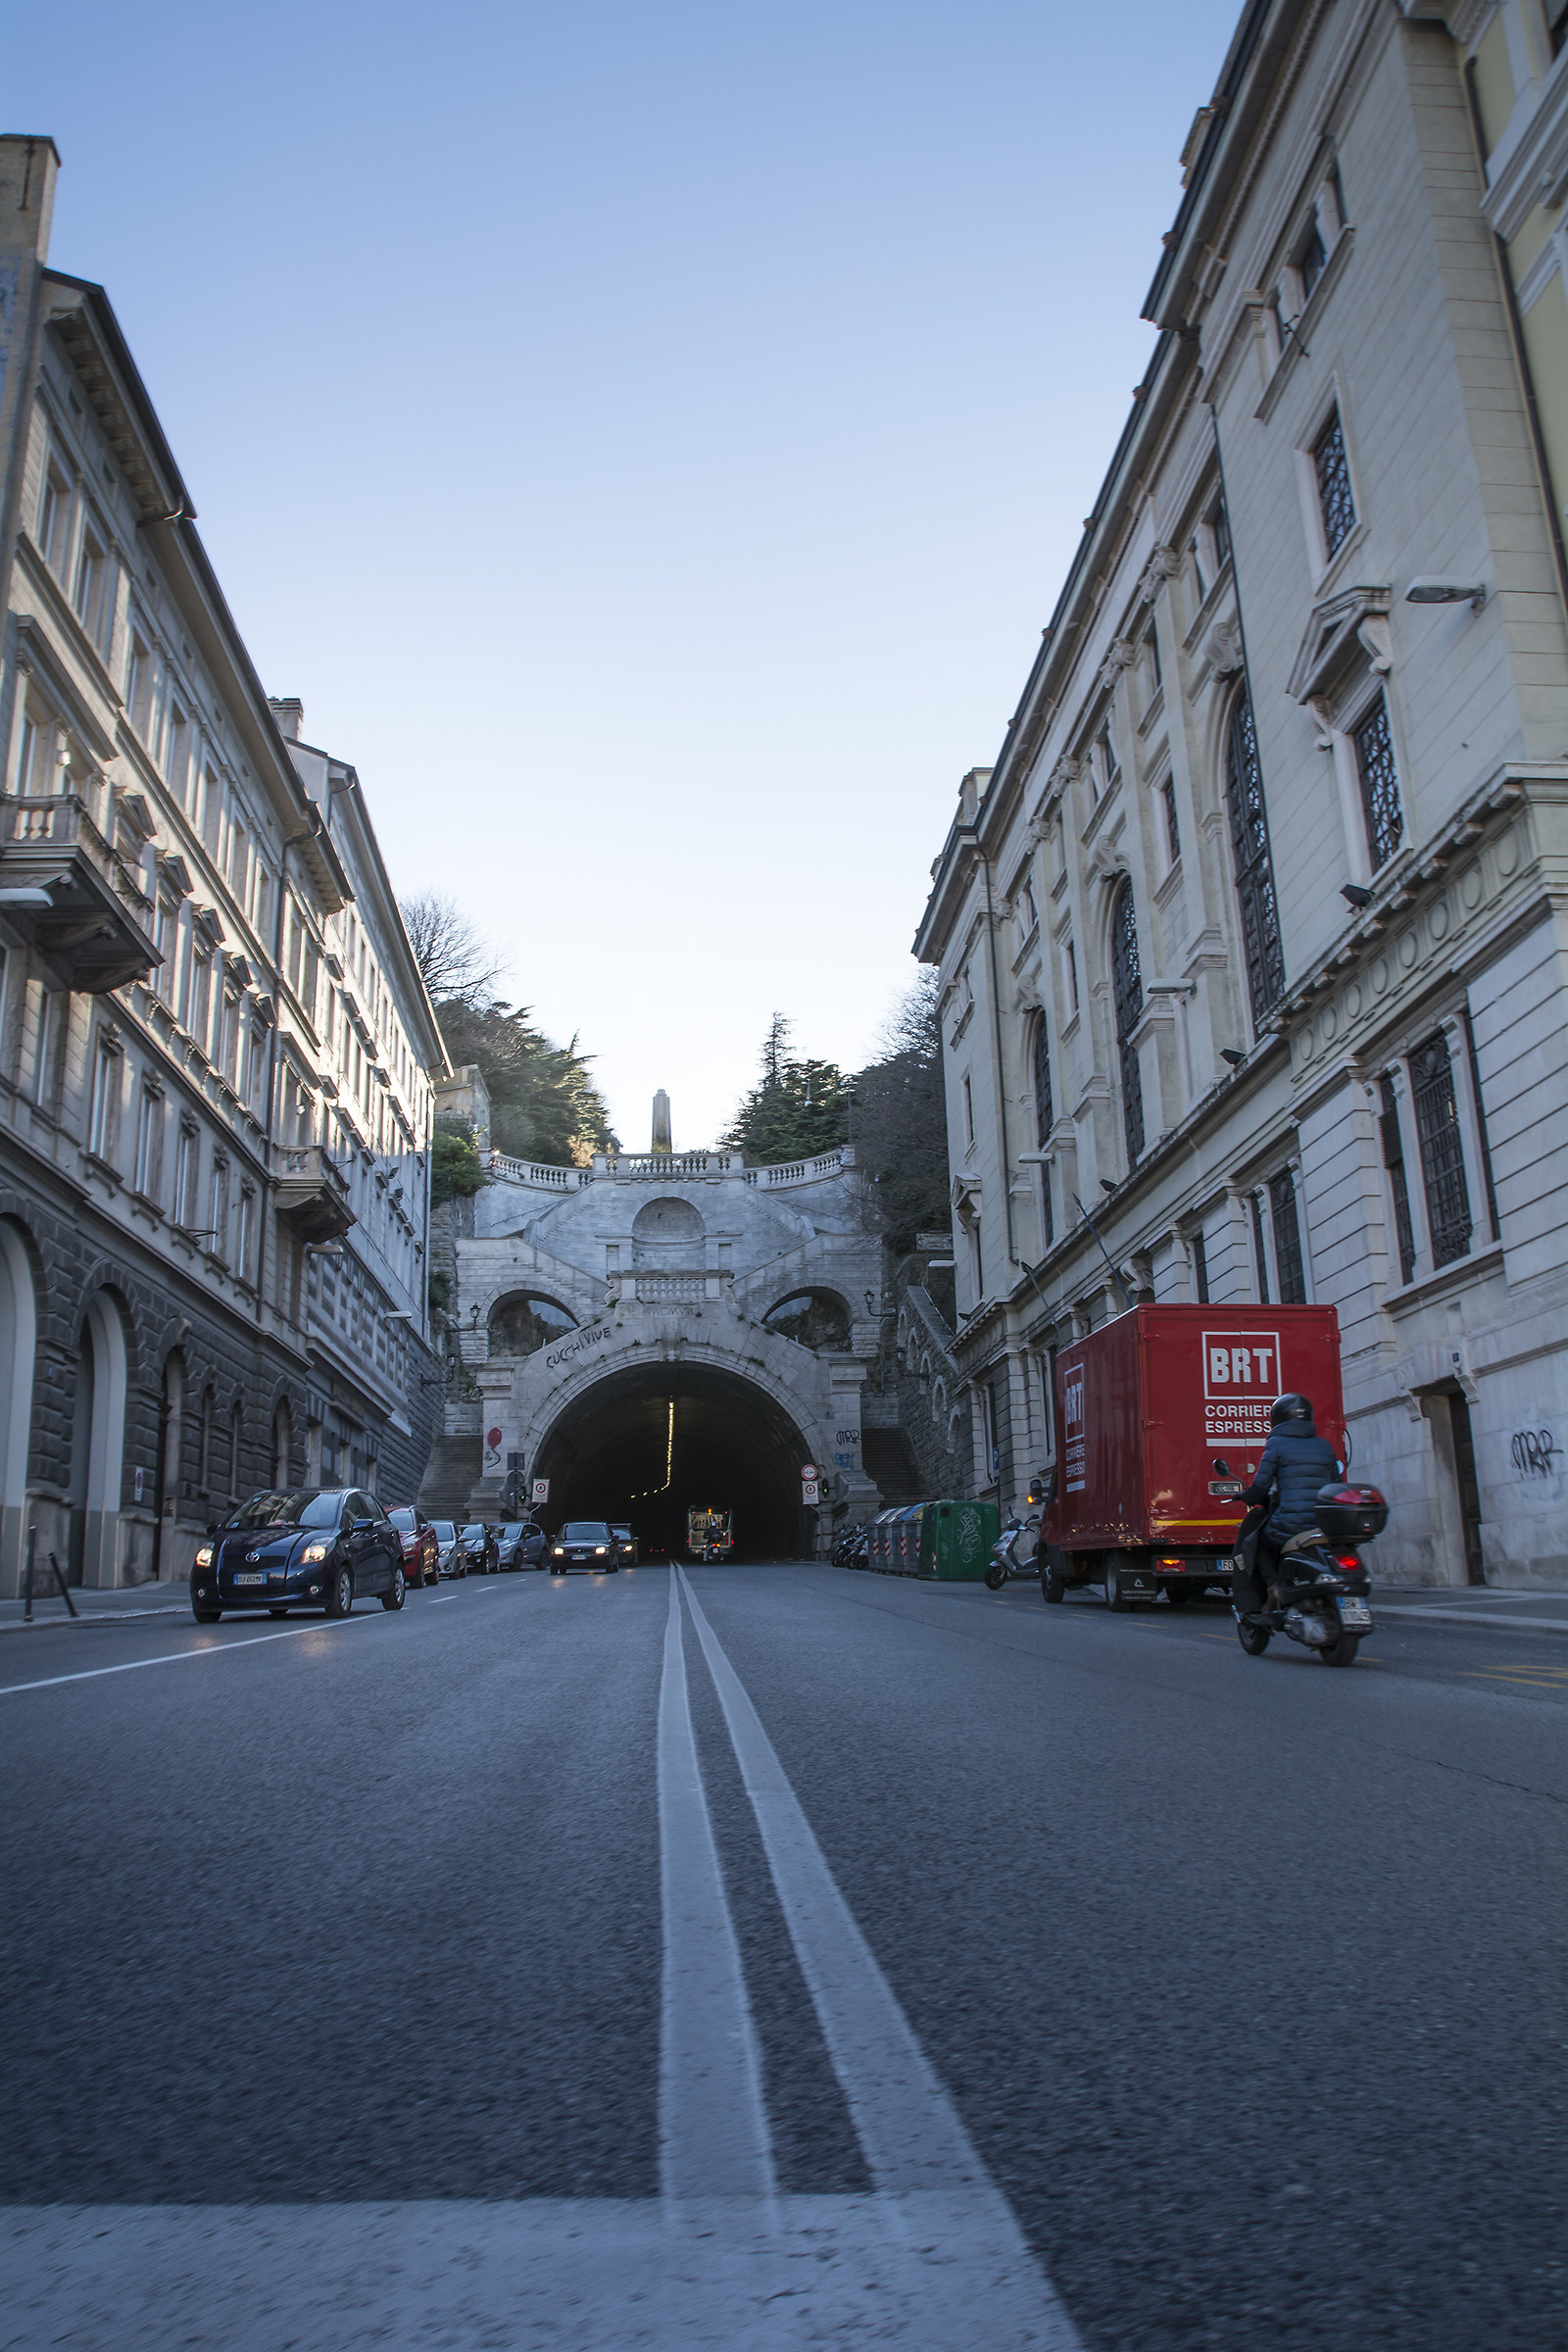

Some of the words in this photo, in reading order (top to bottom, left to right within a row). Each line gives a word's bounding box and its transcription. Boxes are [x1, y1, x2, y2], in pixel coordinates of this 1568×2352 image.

[546, 1337, 585, 1369] CUCCHI
[1209, 1348, 1273, 1384] BRT
[1066, 1382, 1082, 1426] BRT
[1204, 1404, 1272, 1418] CORRIER
[1204, 1420, 1273, 1434] ESPRESS
